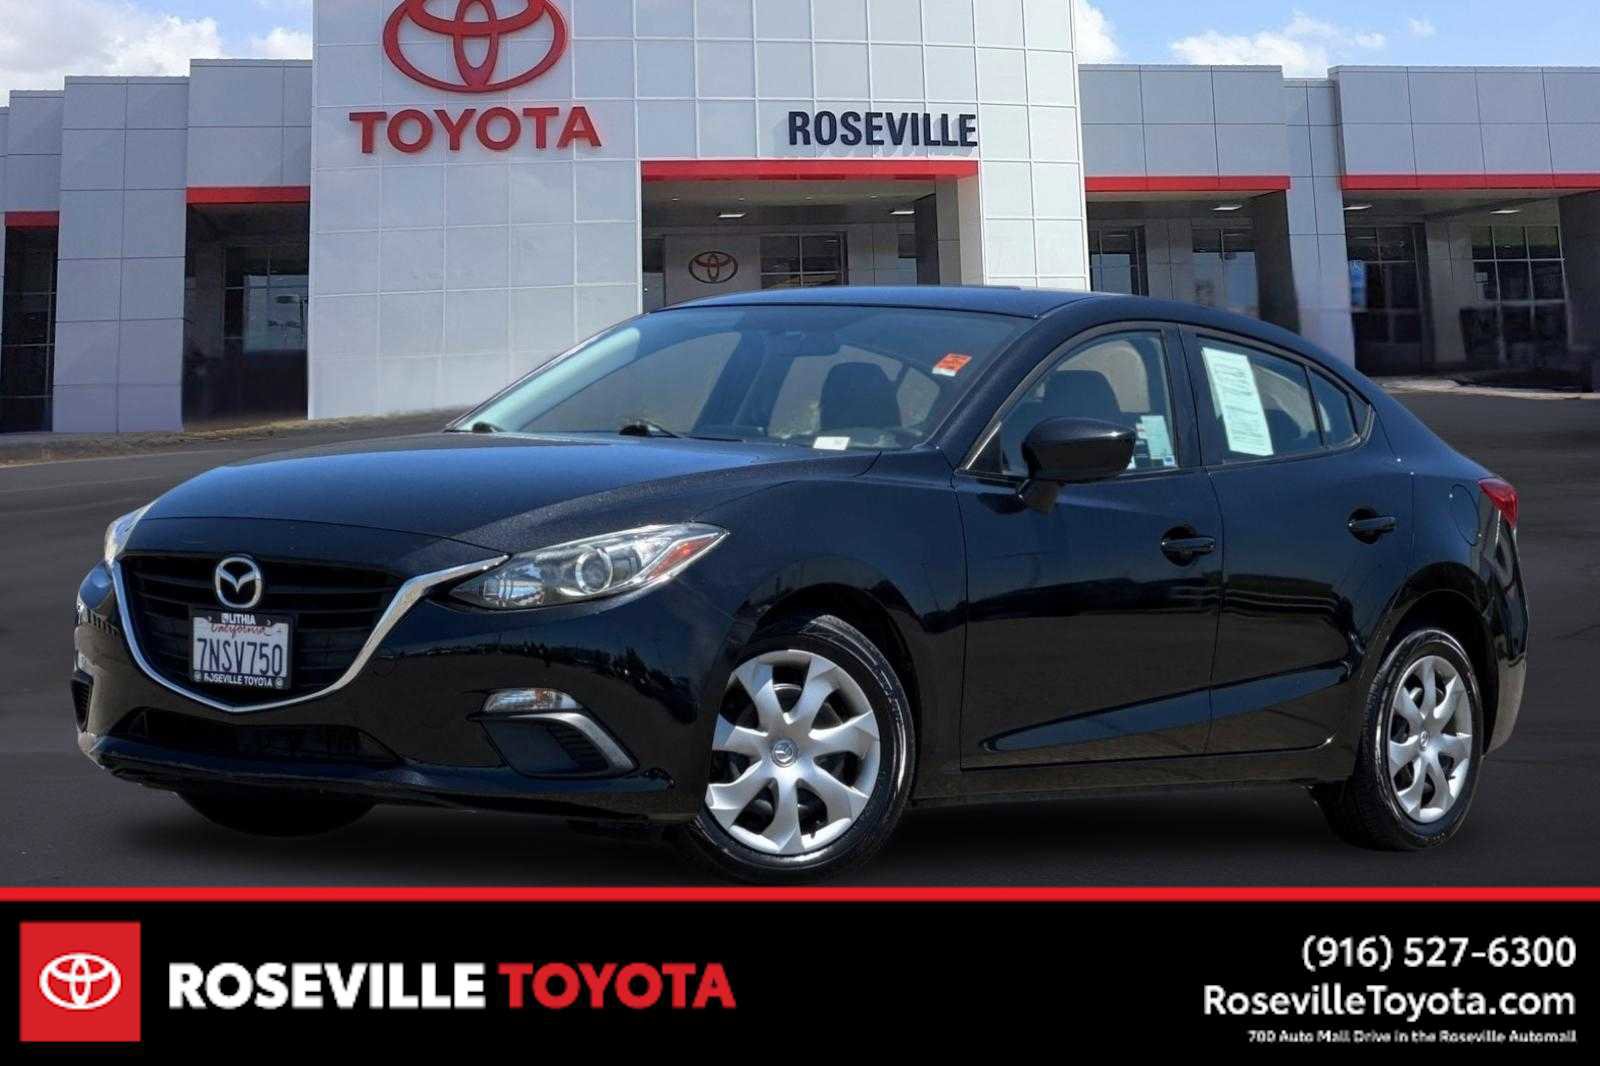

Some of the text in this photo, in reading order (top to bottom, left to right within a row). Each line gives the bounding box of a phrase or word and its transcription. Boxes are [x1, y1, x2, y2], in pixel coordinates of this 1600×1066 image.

[349, 106, 602, 154] TOYOTA
[788, 110, 978, 147] ROSEVILLE
[229, 613, 256, 625] LITHIA
[196, 638, 283, 677] 7NSV750
[204, 672, 274, 687] ROSEVILLE TOYOTA
